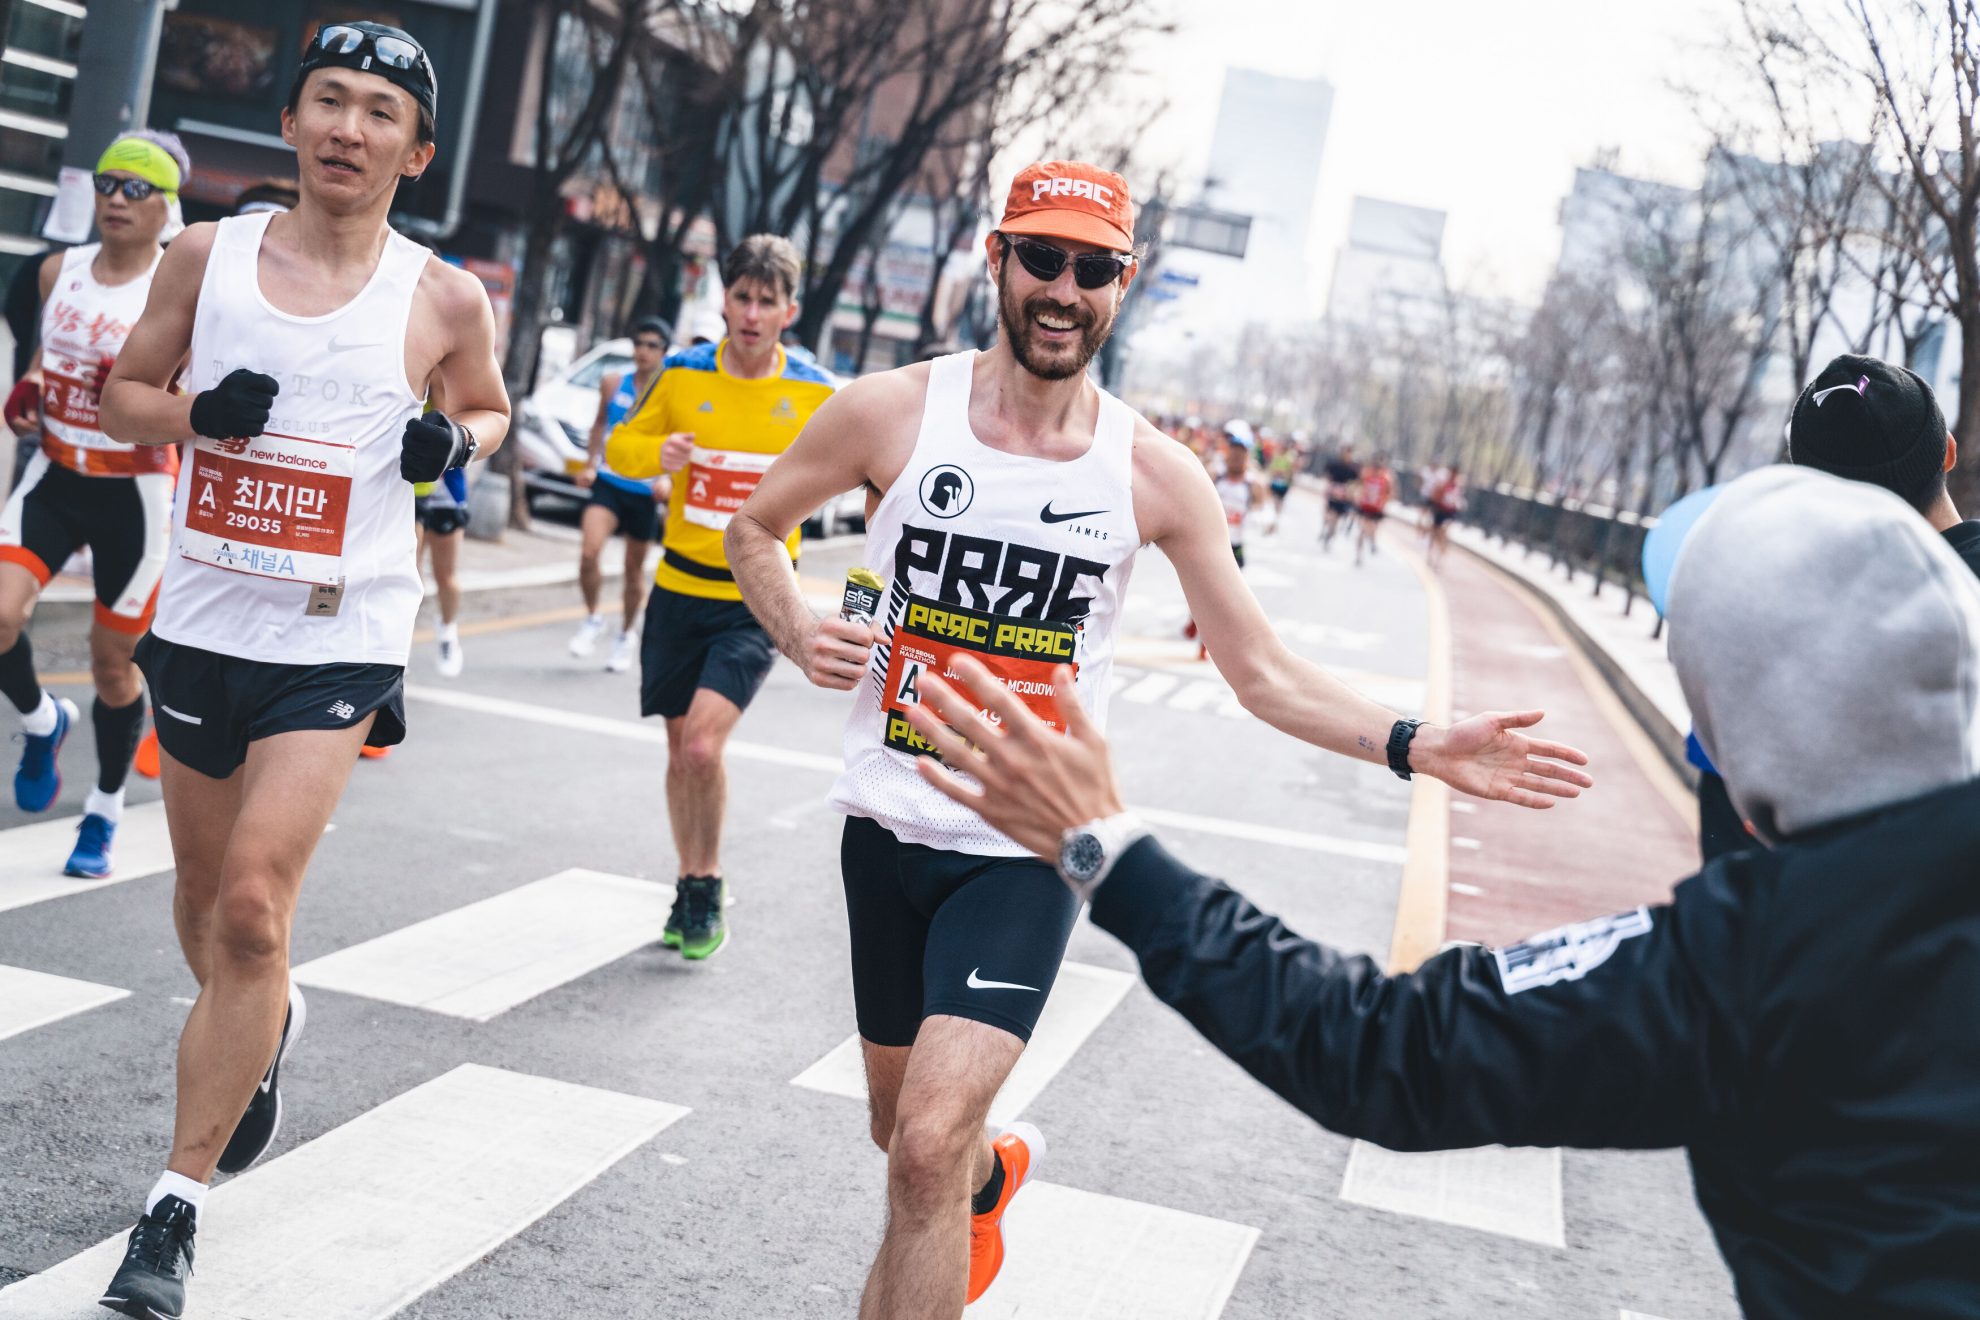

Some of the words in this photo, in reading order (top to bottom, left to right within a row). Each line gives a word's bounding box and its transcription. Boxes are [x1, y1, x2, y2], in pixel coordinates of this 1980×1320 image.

[212, 360, 371, 406] TTOK
[250, 449, 275, 460] new
[277, 452, 327, 469] balance
[198, 482, 216, 510] A
[233, 476, 328, 520] 최지만
[225, 512, 282, 534] 29035
[1068, 523, 1108, 540] JAMES
[240, 547, 295, 575] 채널A
[899, 650, 936, 666] MARATHON
[900, 645, 914, 653] 2019
[915, 649, 936, 661] SEOUL
[898, 664, 919, 704] A
